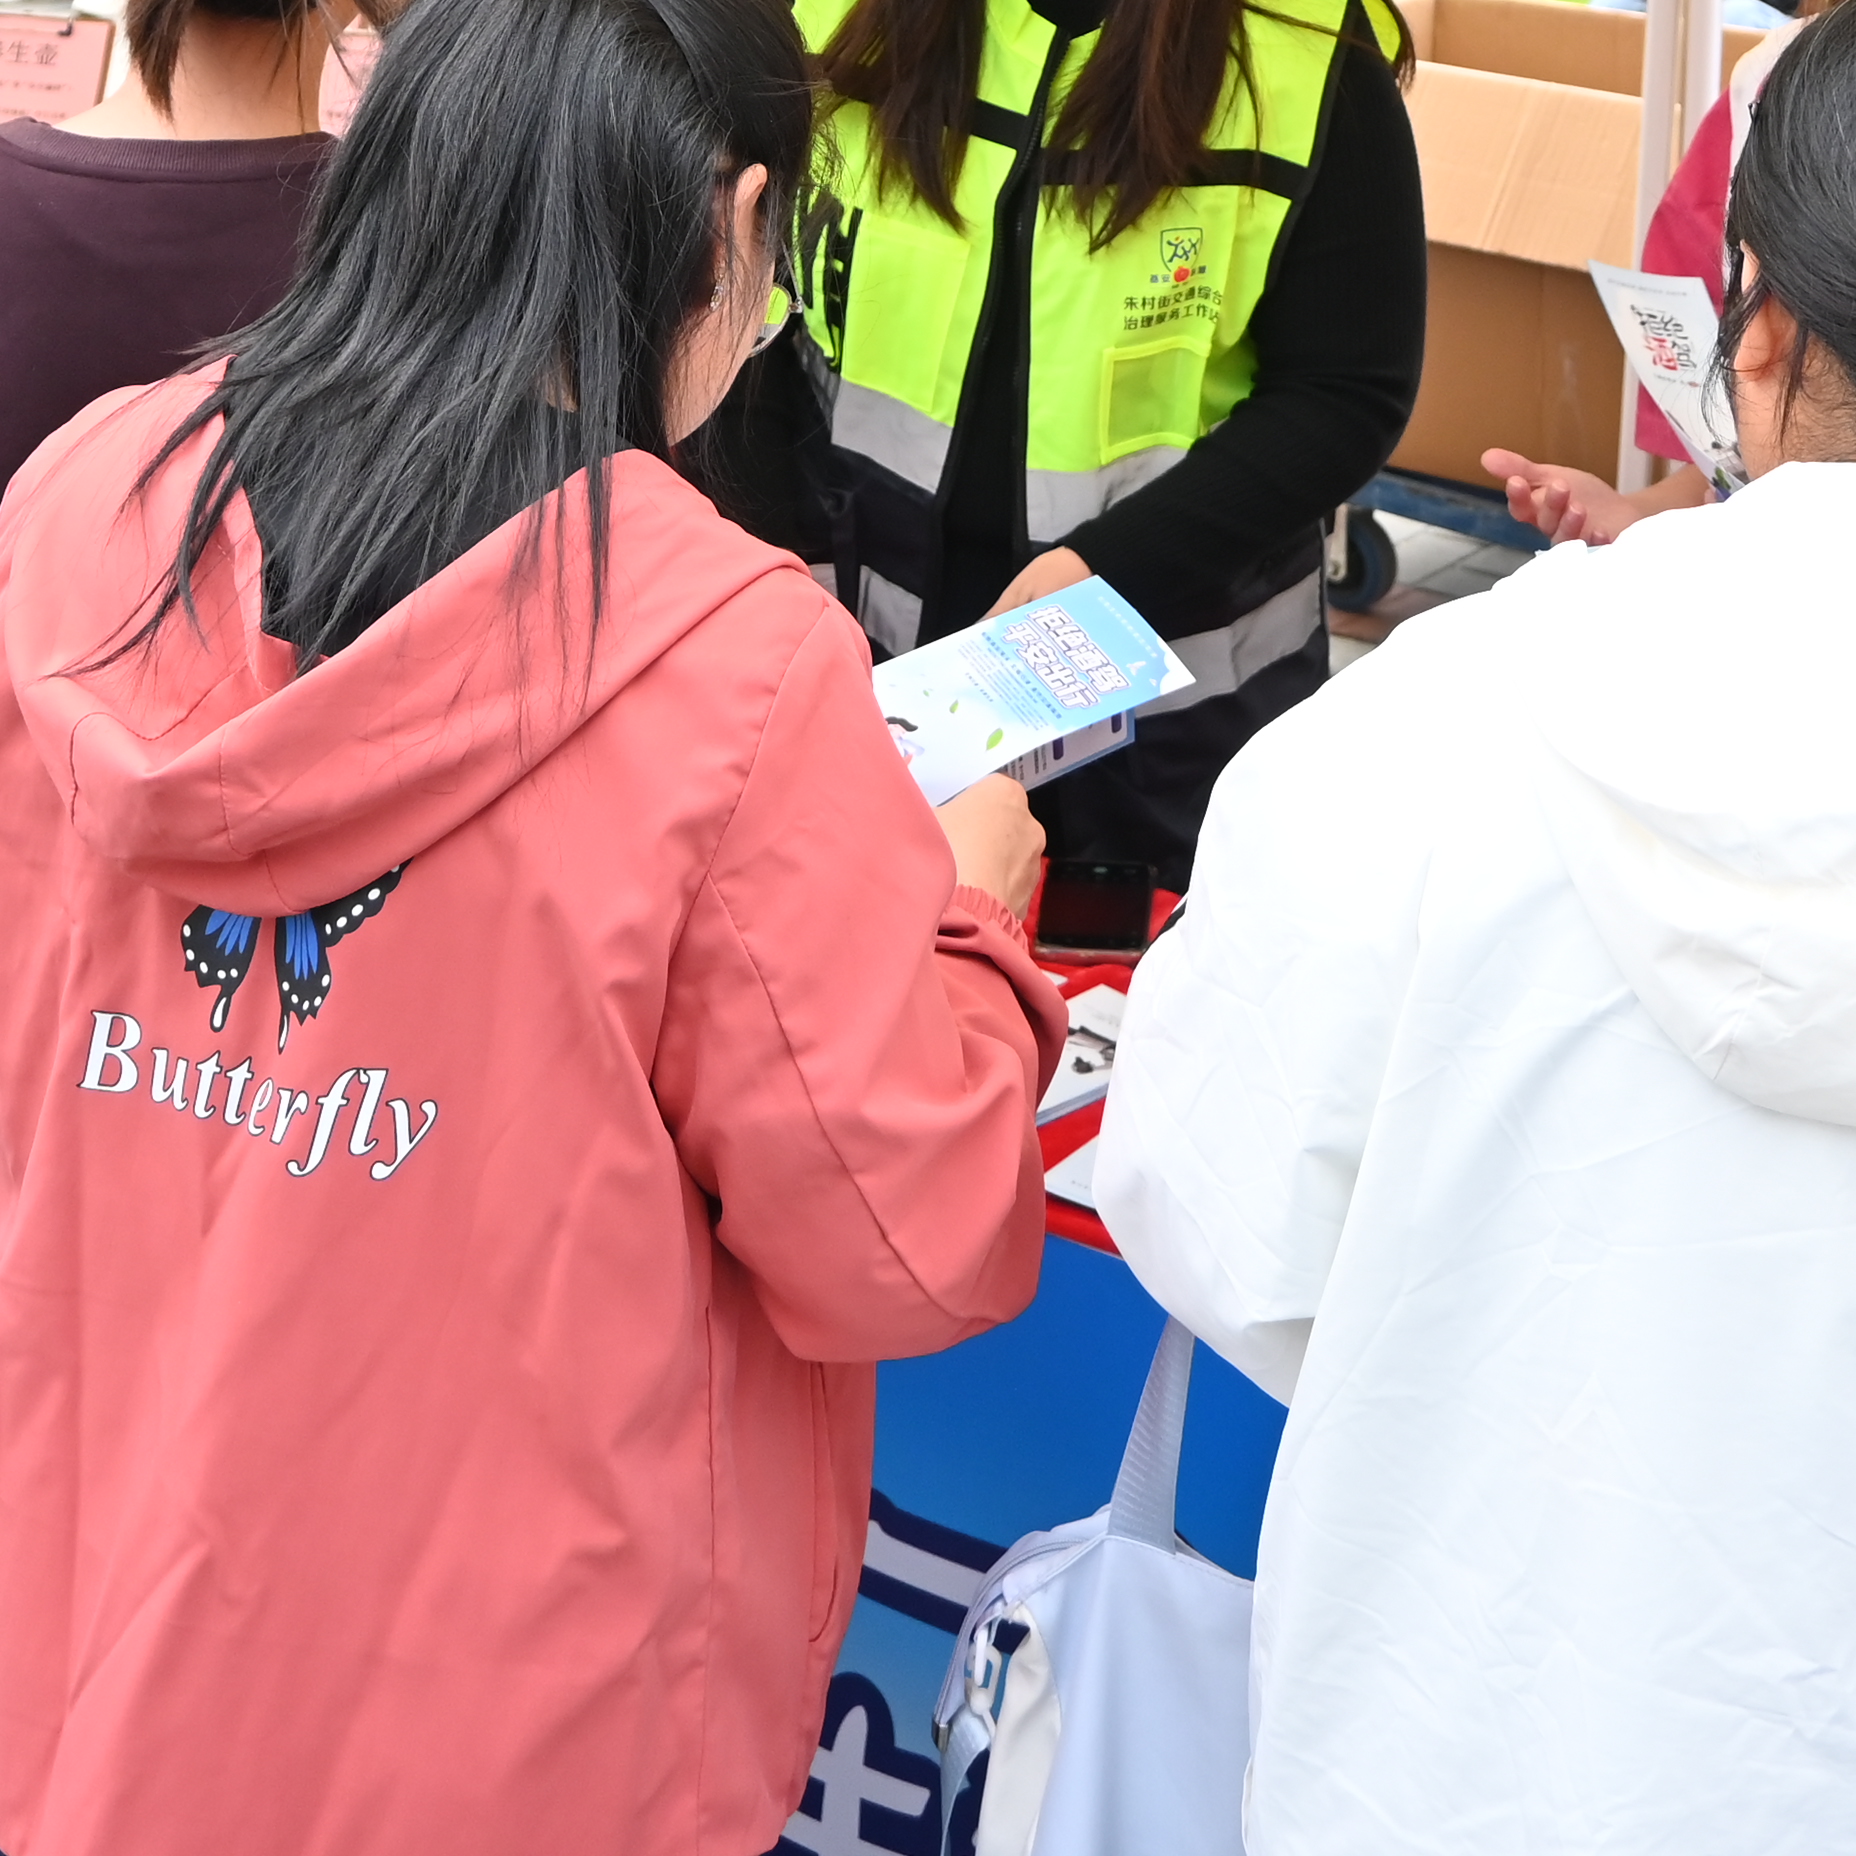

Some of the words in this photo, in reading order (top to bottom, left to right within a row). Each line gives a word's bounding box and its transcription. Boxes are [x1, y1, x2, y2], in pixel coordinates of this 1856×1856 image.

[1123, 284, 1224, 311] 朱村街交通综合
[1001, 621, 1101, 709] 平安出行
[1025, 604, 1132, 695] 拒绝酒驾
[76, 1010, 438, 1181] Butterfly
